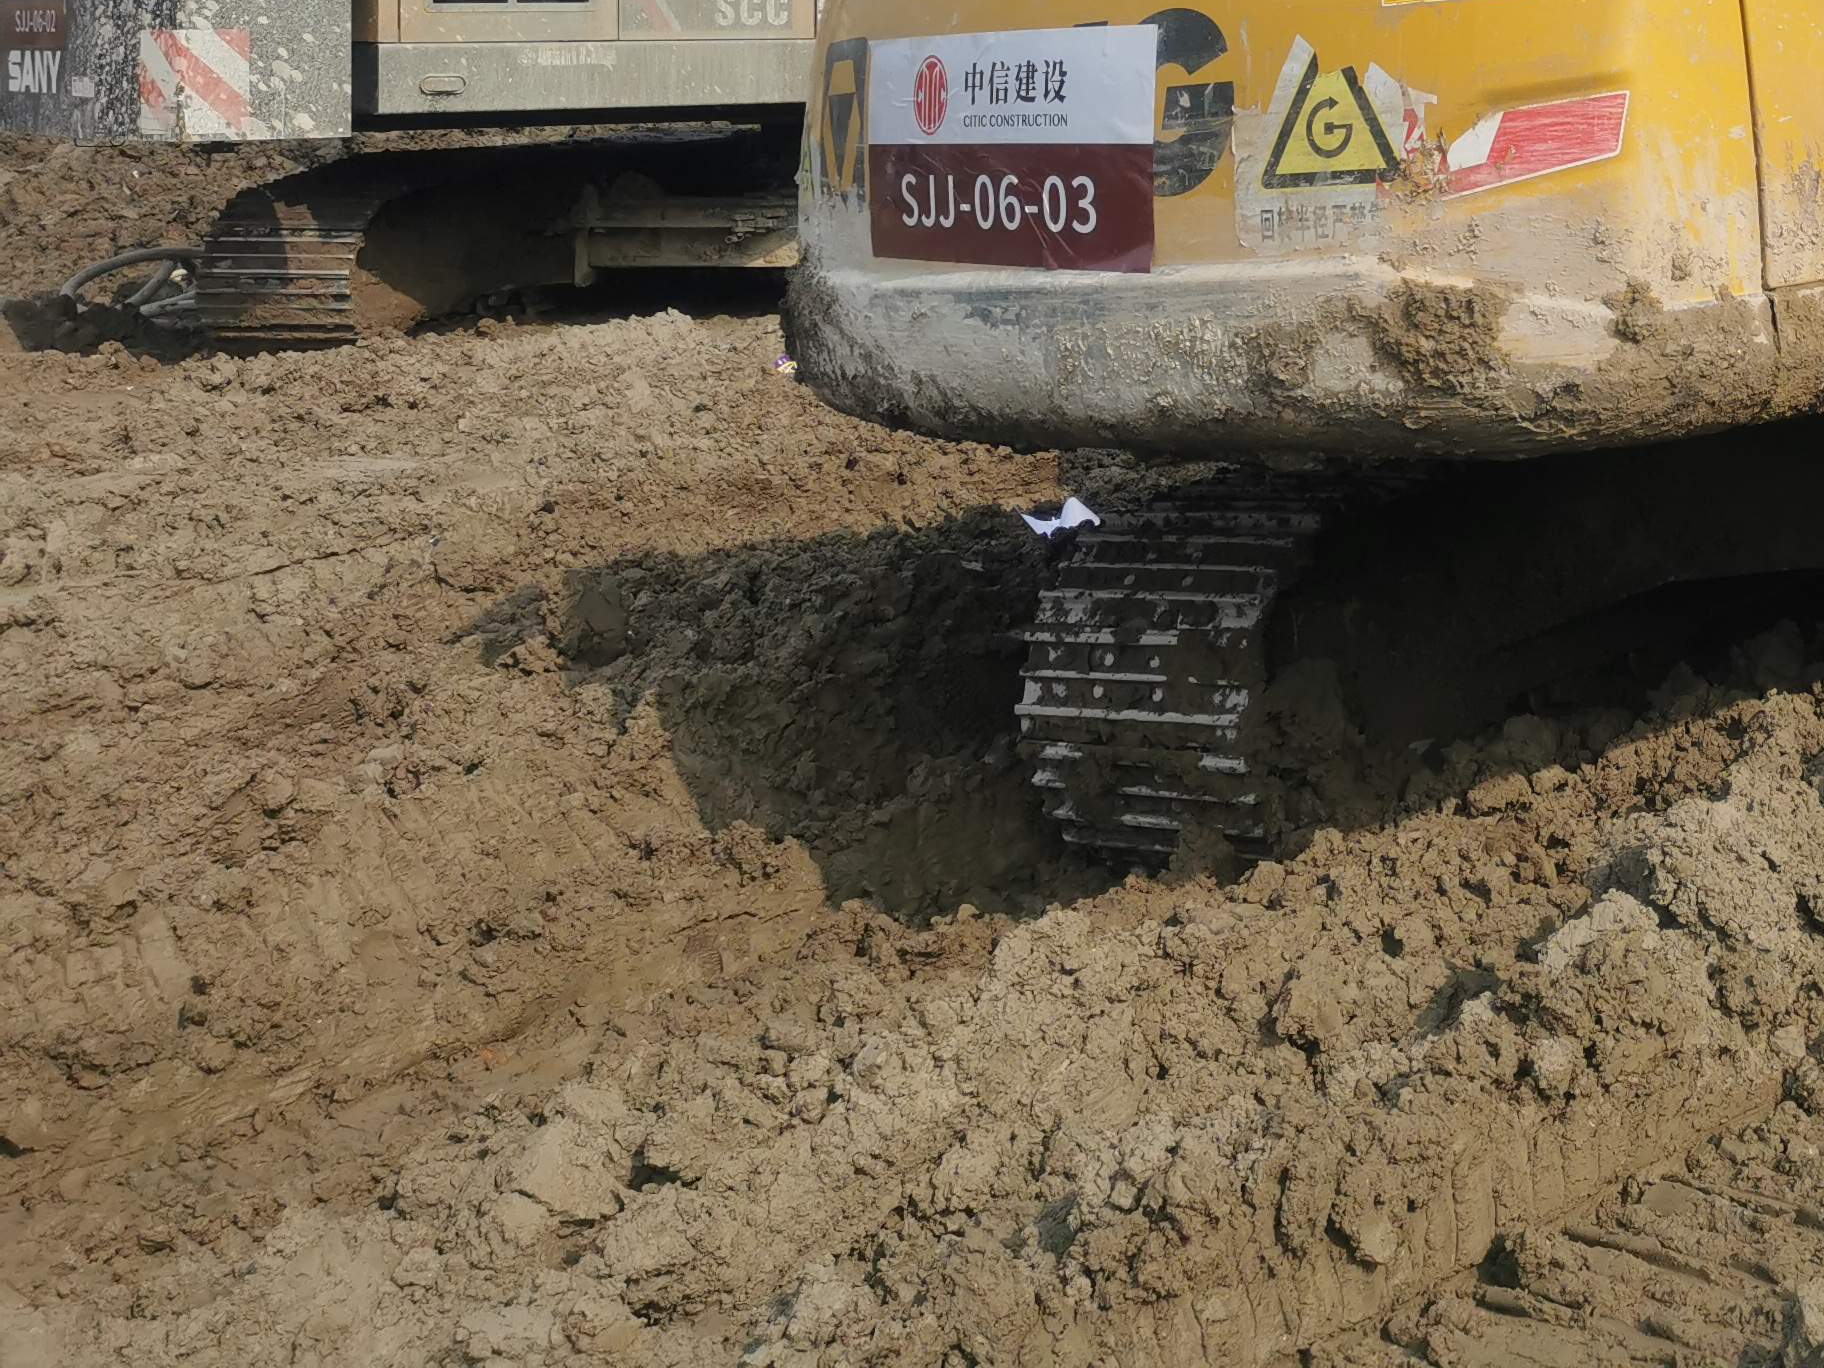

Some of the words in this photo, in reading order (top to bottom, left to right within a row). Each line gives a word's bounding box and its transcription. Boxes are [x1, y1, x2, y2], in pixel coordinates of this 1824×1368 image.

[8, 50, 61, 94] SANY
[964, 59, 1068, 106] 中信建设
[963, 114, 987, 128] CITIC
[989, 113, 1068, 128] CONSTRUCTION
[901, 173, 1097, 234] SJJ-06-03
